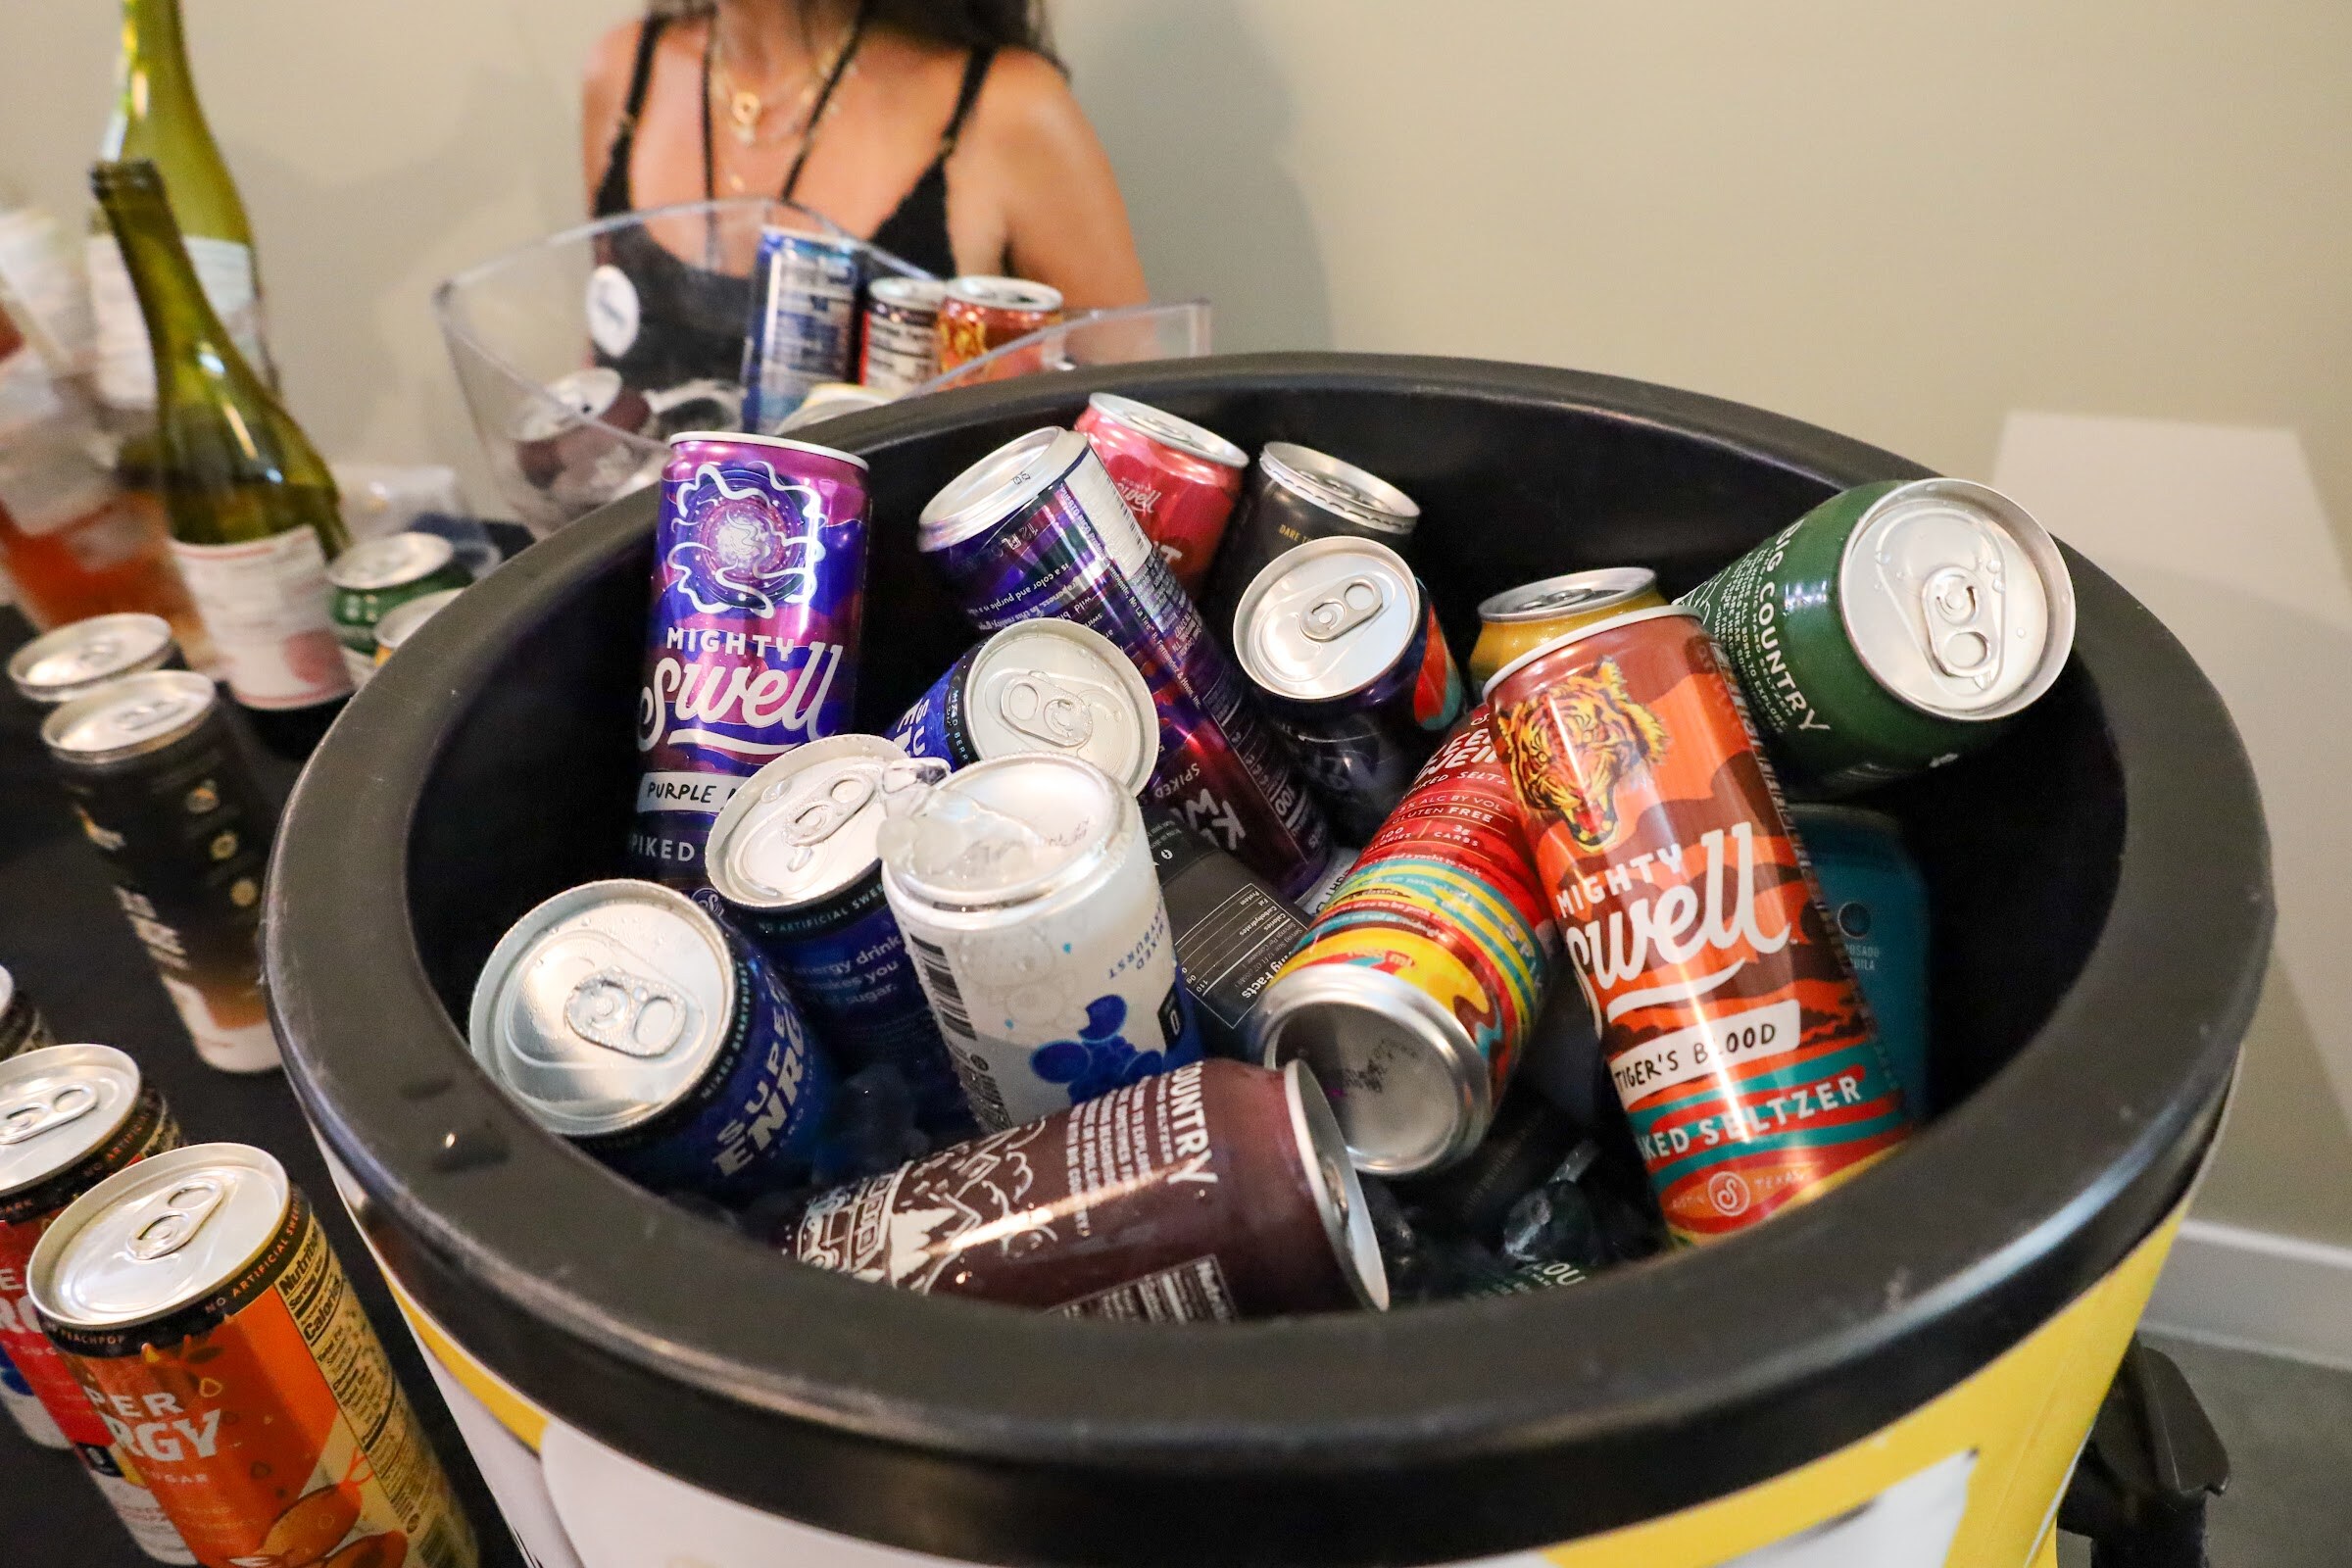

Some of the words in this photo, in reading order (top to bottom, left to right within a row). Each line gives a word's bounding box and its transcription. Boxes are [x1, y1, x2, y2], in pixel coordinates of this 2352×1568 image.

[1279, 524, 1301, 541] DARE
[1767, 517, 1805, 572] BIG
[1034, 574, 1054, 590] color
[990, 592, 1014, 612] purple
[1015, 587, 1032, 602] and
[1073, 596, 1092, 614] wild
[666, 626, 798, 662] MIGHTY
[1740, 626, 1752, 660] BORN
[1747, 662, 1757, 677] TO
[1758, 581, 1831, 730] COUNTRY
[638, 642, 843, 752] Swell
[954, 731, 969, 760] BERR
[1153, 762, 1200, 800] SPIKED
[1456, 770, 1507, 785] SELTZ
[647, 780, 717, 804] PURPLE
[1419, 795, 1446, 806] ALC
[1473, 797, 1502, 812] VOL
[1392, 807, 1445, 825] GLUTEN
[1448, 807, 1494, 823] FREE
[1380, 826, 1404, 841] 100
[1434, 831, 1479, 847] CARBS
[628, 837, 695, 862] PIKED
[1414, 854, 1444, 864] yacht
[1445, 857, 1456, 865] to
[1555, 841, 1685, 917] MIGHTY
[779, 907, 849, 933] ARTIFICIAL
[852, 882, 884, 909] SWEE
[1239, 889, 1259, 906] Protein
[1257, 897, 1268, 906] Fat
[1238, 904, 1277, 937] Carbohydrates
[1262, 911, 1286, 931] Calories
[856, 935, 901, 965] drink
[864, 960, 900, 984] you
[1185, 973, 1197, 985] 0g
[1242, 969, 1275, 999] Facts
[1194, 977, 1208, 992] 110
[1613, 1046, 1680, 1094] TIGER'S
[1693, 1022, 1777, 1065] BOOD
[1639, 1125, 1690, 1163] KED
[1698, 1076, 1862, 1147] SELTZER
[204, 1296, 227, 1313] NO
[231, 1237, 290, 1298] ARTIFICIAL
